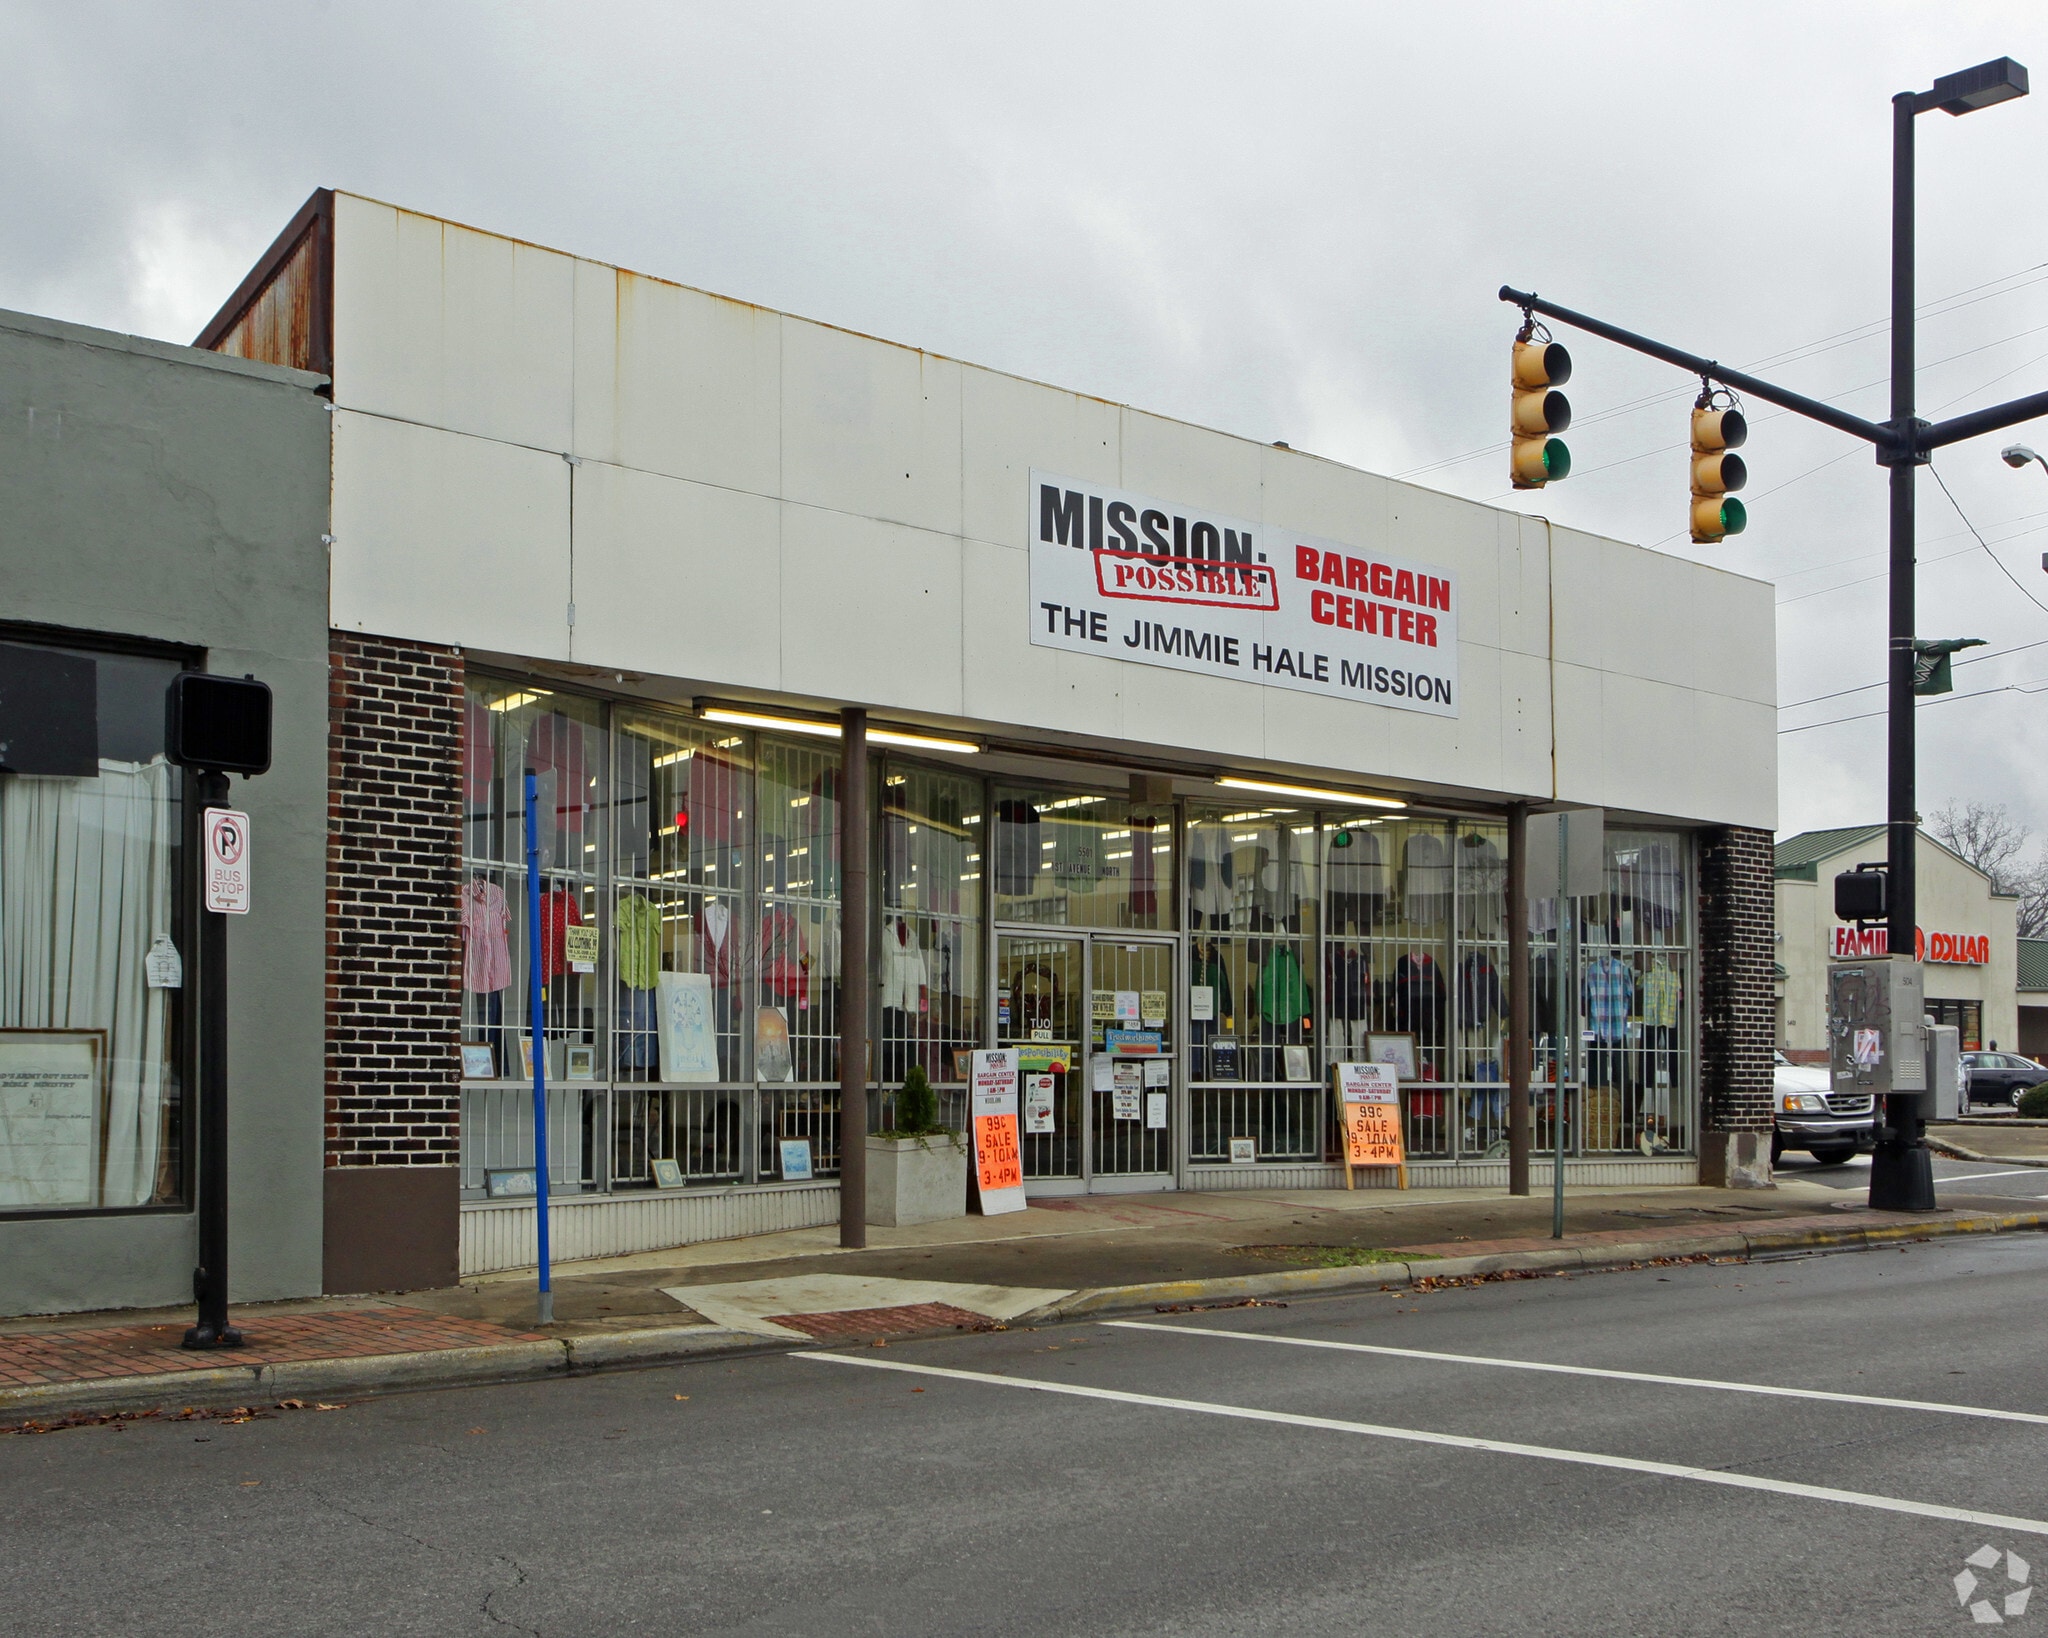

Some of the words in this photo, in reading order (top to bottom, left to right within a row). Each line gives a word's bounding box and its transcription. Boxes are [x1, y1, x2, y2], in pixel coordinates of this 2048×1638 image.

[1039, 484, 1267, 583] MISSION:
[1114, 564, 1262, 598] POSSIBLE
[1295, 544, 1451, 612] BARGAIN
[1311, 589, 1438, 648] CENTER
[1040, 602, 1108, 643] THE
[1123, 619, 1240, 667] JIMMIE
[1252, 643, 1329, 683] HALE
[1341, 659, 1452, 705] MISSION
[1078, 846, 1093, 858] 5501
[214, 868, 241, 882] BUS
[1069, 863, 1091, 875] AVENUE
[1102, 866, 1120, 877] NORTH
[211, 881, 244, 894] STOP
[1836, 927, 1888, 956] FAMIL
[1931, 932, 1989, 963] DOLLAR
[1034, 1031, 1049, 1039] PULL
[1212, 1041, 1236, 1050] OPEN
[1356, 1120, 1387, 1132] SALE
[985, 1132, 1011, 1148] SALE
